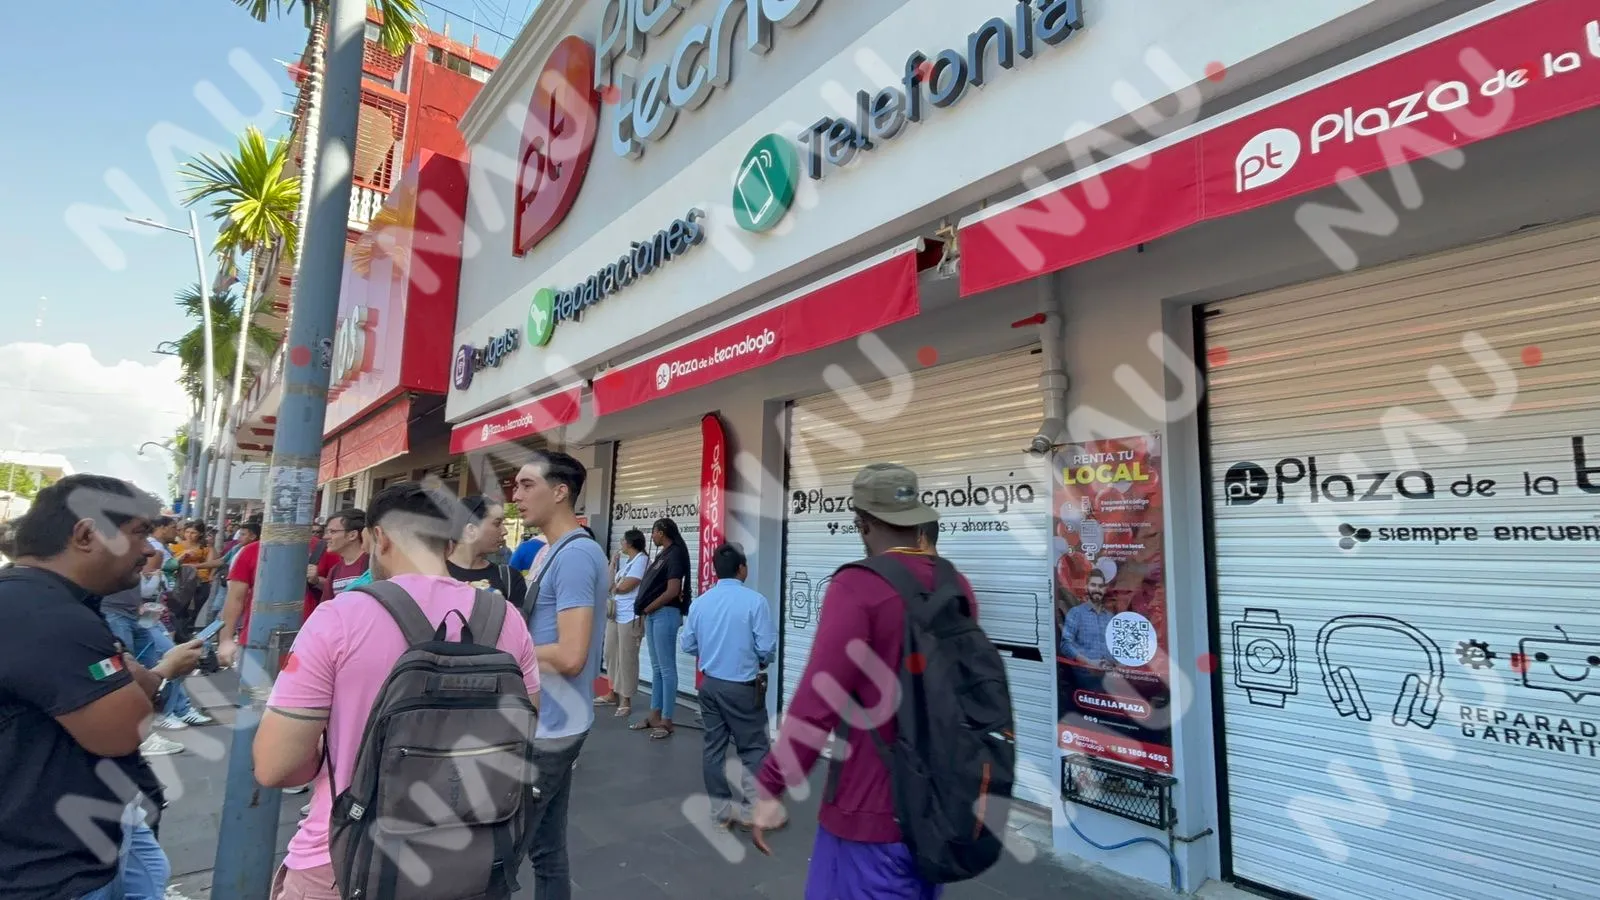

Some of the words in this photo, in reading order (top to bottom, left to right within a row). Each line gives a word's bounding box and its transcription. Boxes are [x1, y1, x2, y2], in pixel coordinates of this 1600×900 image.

[1310, 81, 1470, 154] Plaza
[1480, 69, 1530, 97] de
[1543, 52, 1581, 78] la
[551, 207, 706, 323] Reparaciones
[670, 359, 698, 379] Plaza
[1073, 451, 1115, 465] RENTA
[1118, 450, 1134, 461] TU
[1063, 462, 1149, 485] LOCAL
[1226, 467, 1265, 506] pt
[1274, 456, 1436, 504] Plaza
[1450, 474, 1496, 497] de
[1524, 471, 1559, 496] la
[961, 518, 1010, 532] ahorras
[1378, 525, 1478, 544] siempre
[1078, 693, 1101, 706] CÁELE
[1101, 698, 1107, 706] A
[1107, 700, 1118, 709] LA
[1118, 701, 1145, 713] PLAZA
[1460, 705, 1598, 738] REPARAD
